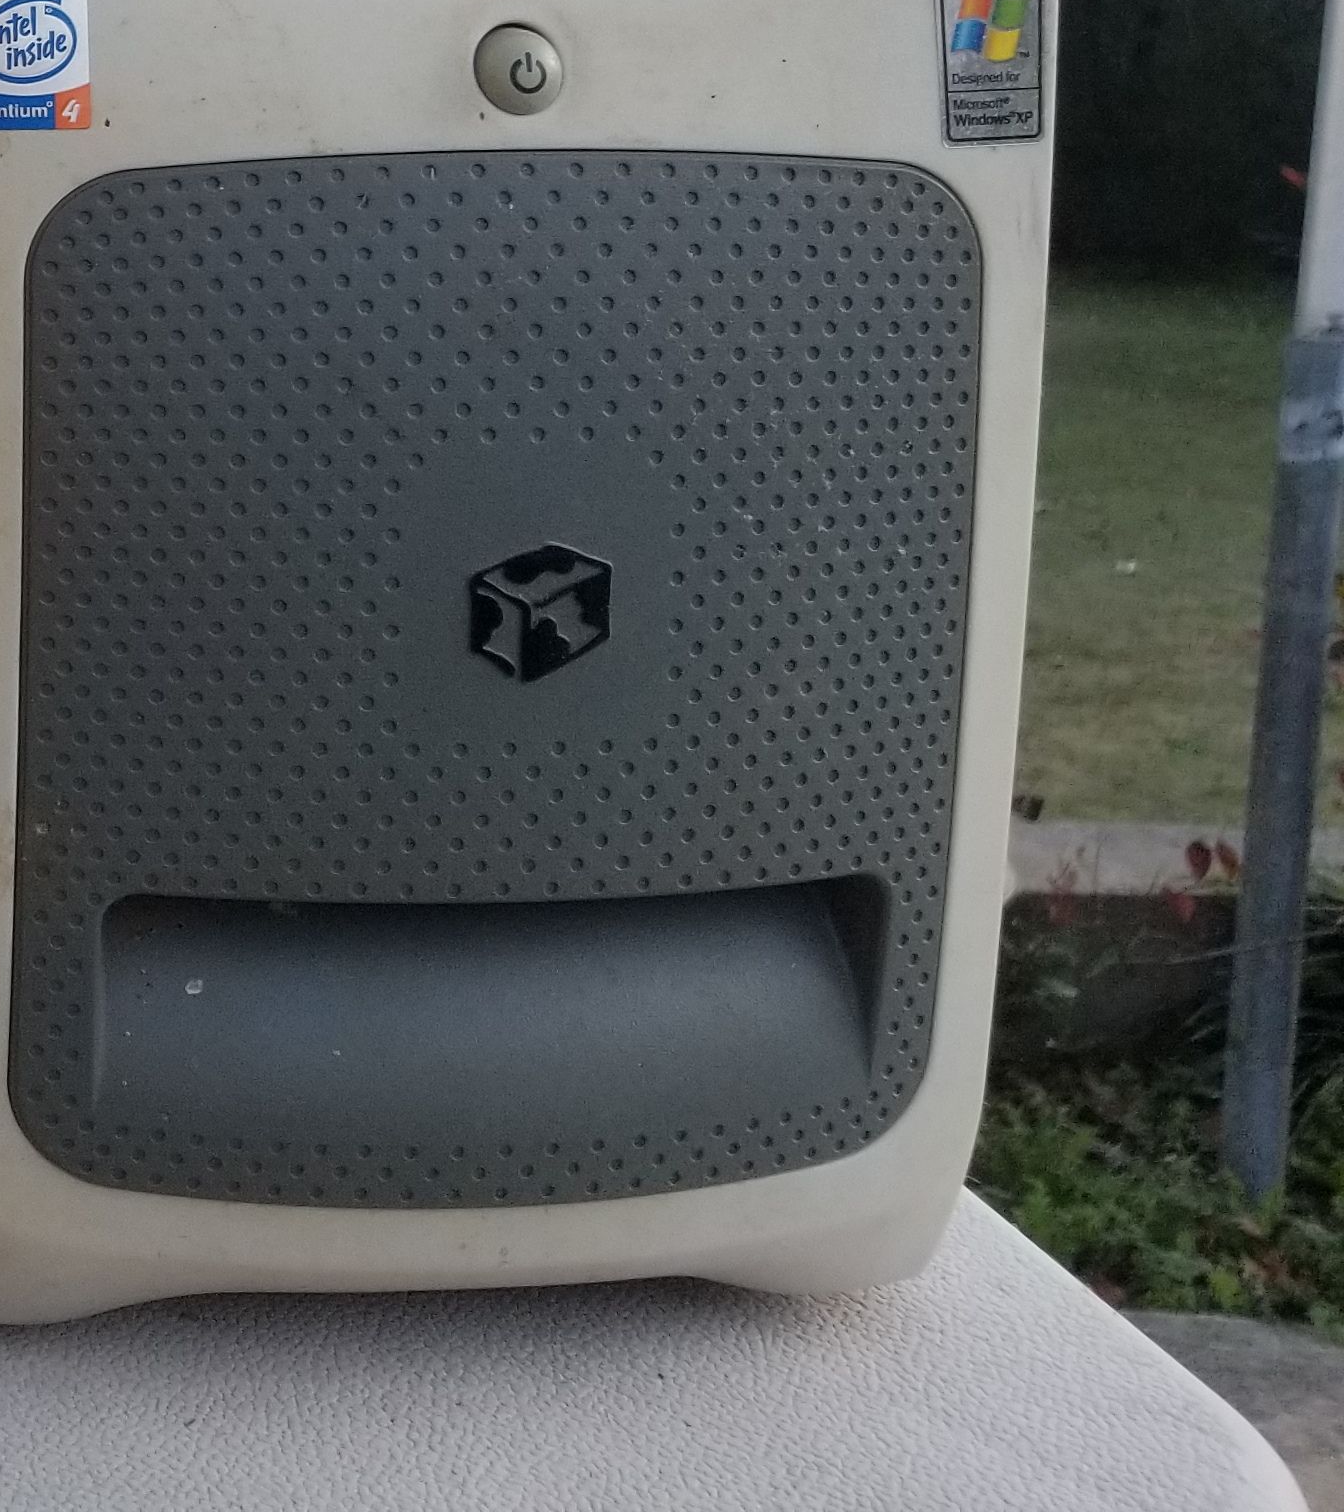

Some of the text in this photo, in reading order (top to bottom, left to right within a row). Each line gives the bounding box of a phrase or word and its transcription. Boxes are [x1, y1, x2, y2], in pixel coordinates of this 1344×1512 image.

[6, 30, 68, 70] inside
[951, 70, 1021, 85] Designed for
[62, 99, 80, 123] 4
